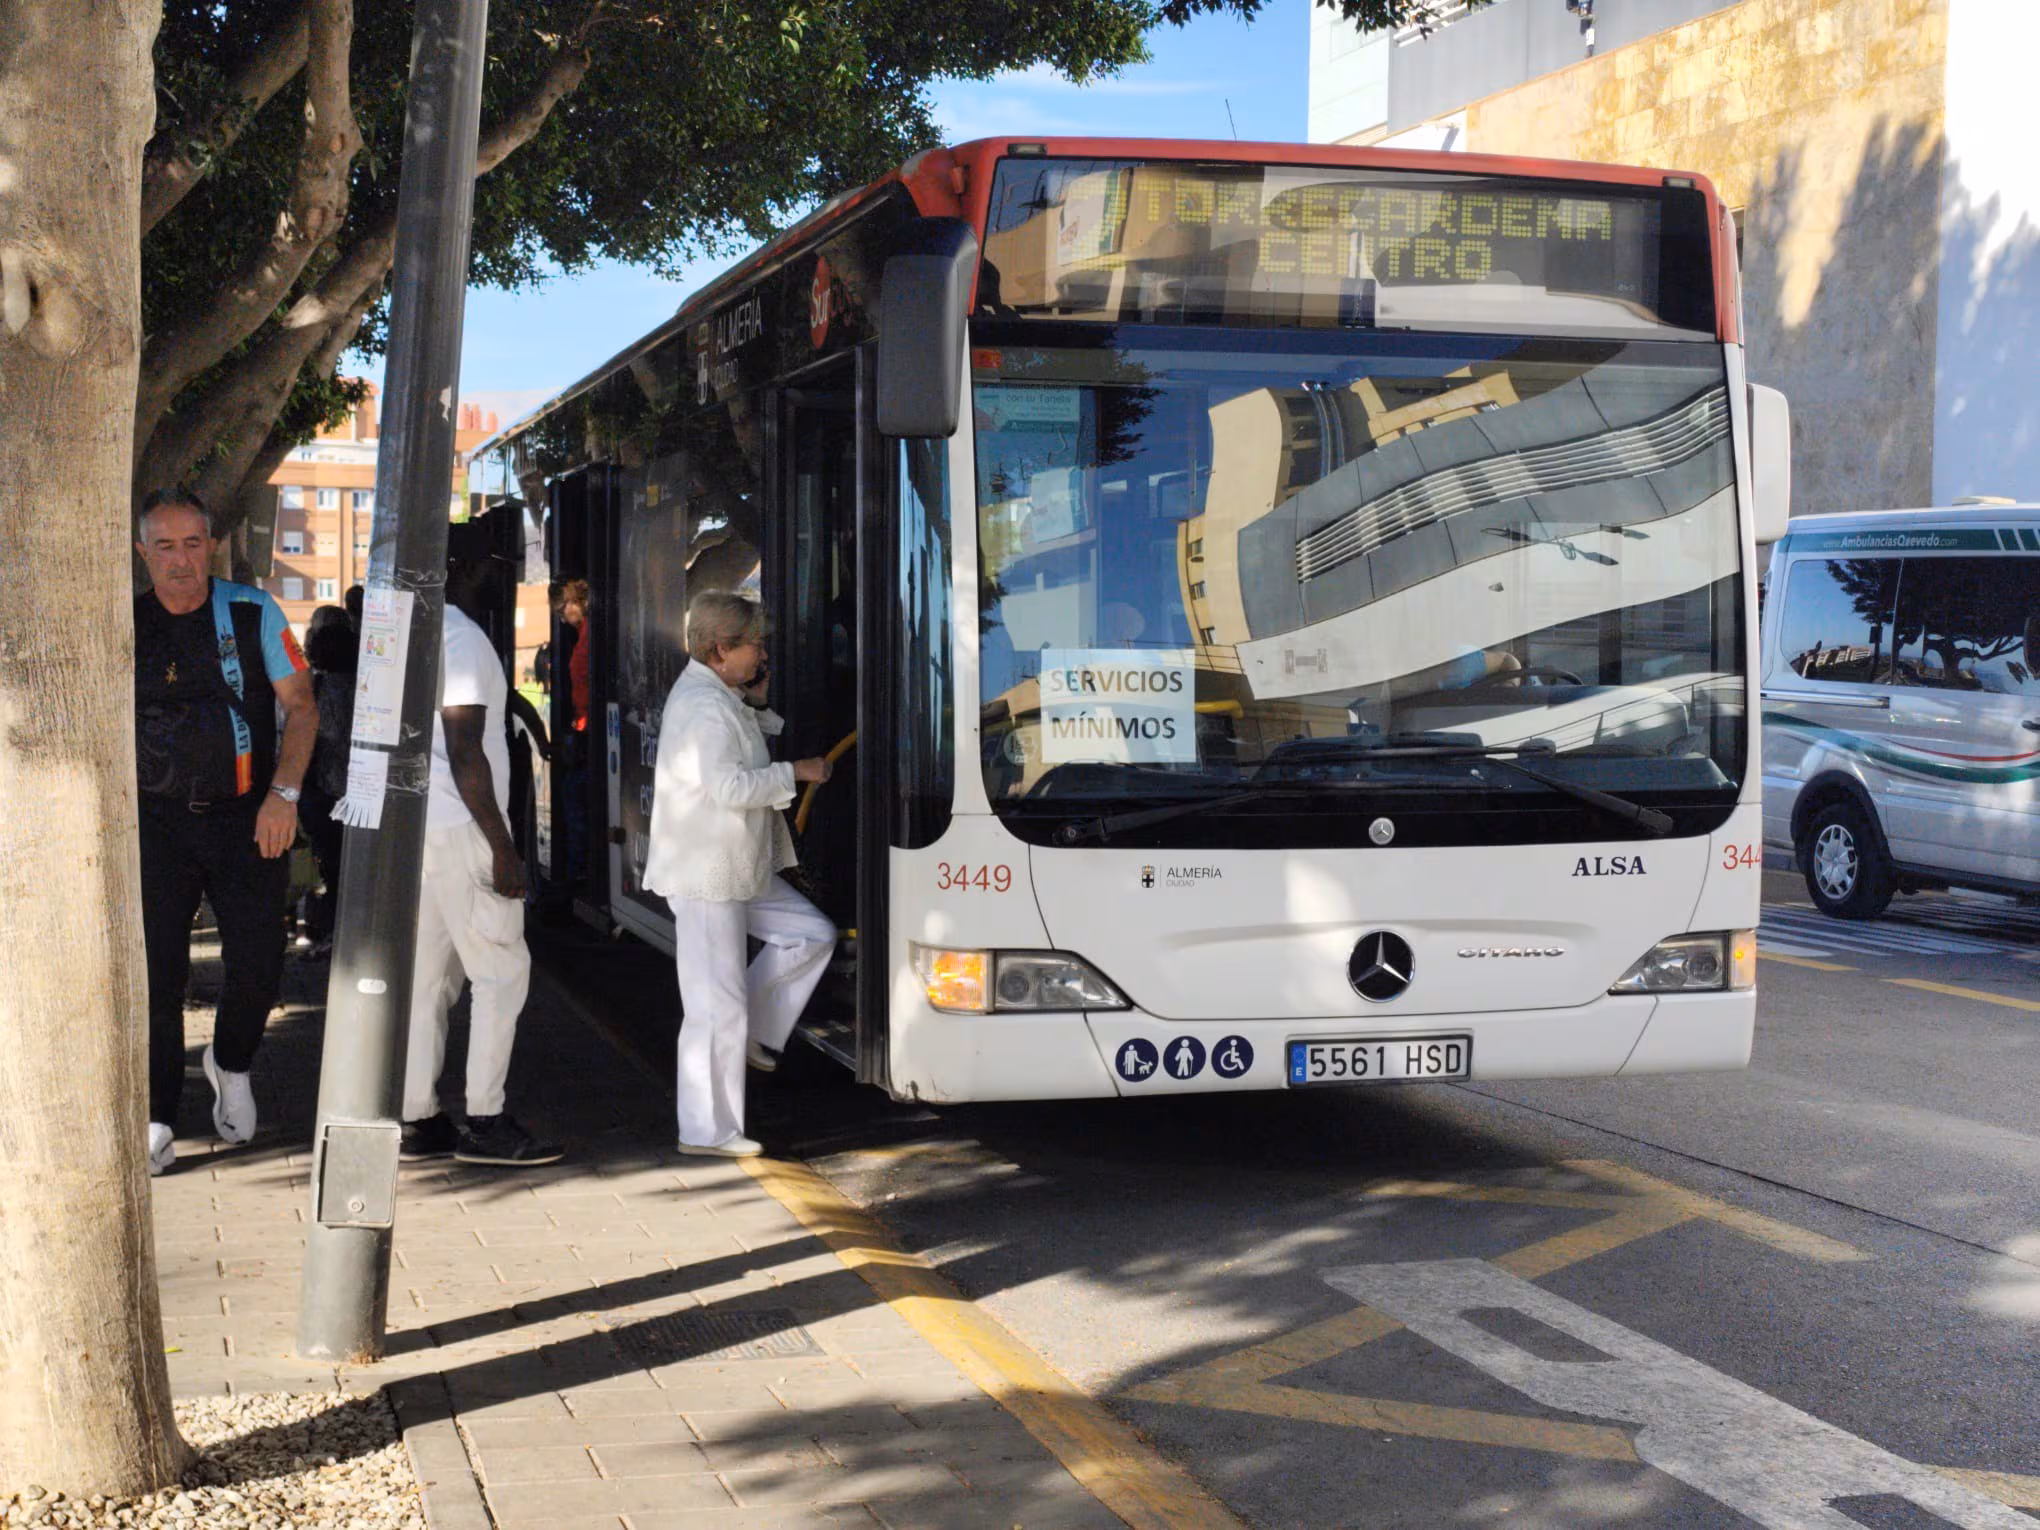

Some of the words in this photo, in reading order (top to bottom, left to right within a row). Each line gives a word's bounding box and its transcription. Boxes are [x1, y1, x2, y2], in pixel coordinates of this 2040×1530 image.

[1258, 231, 1492, 281] CENTRO
[716, 286, 763, 355] ALMERÍA
[1049, 669, 1184, 694] SERVICIOS
[1051, 711, 1177, 740] MÍNIMOS
[937, 861, 1012, 893] 3449
[1166, 864, 1222, 879] ALMERÍA
[1571, 855, 1648, 877] ALSA
[1295, 1067, 1304, 1076] E
[1310, 1045, 1385, 1079] 5561
[1405, 1043, 1462, 1076] HSD
